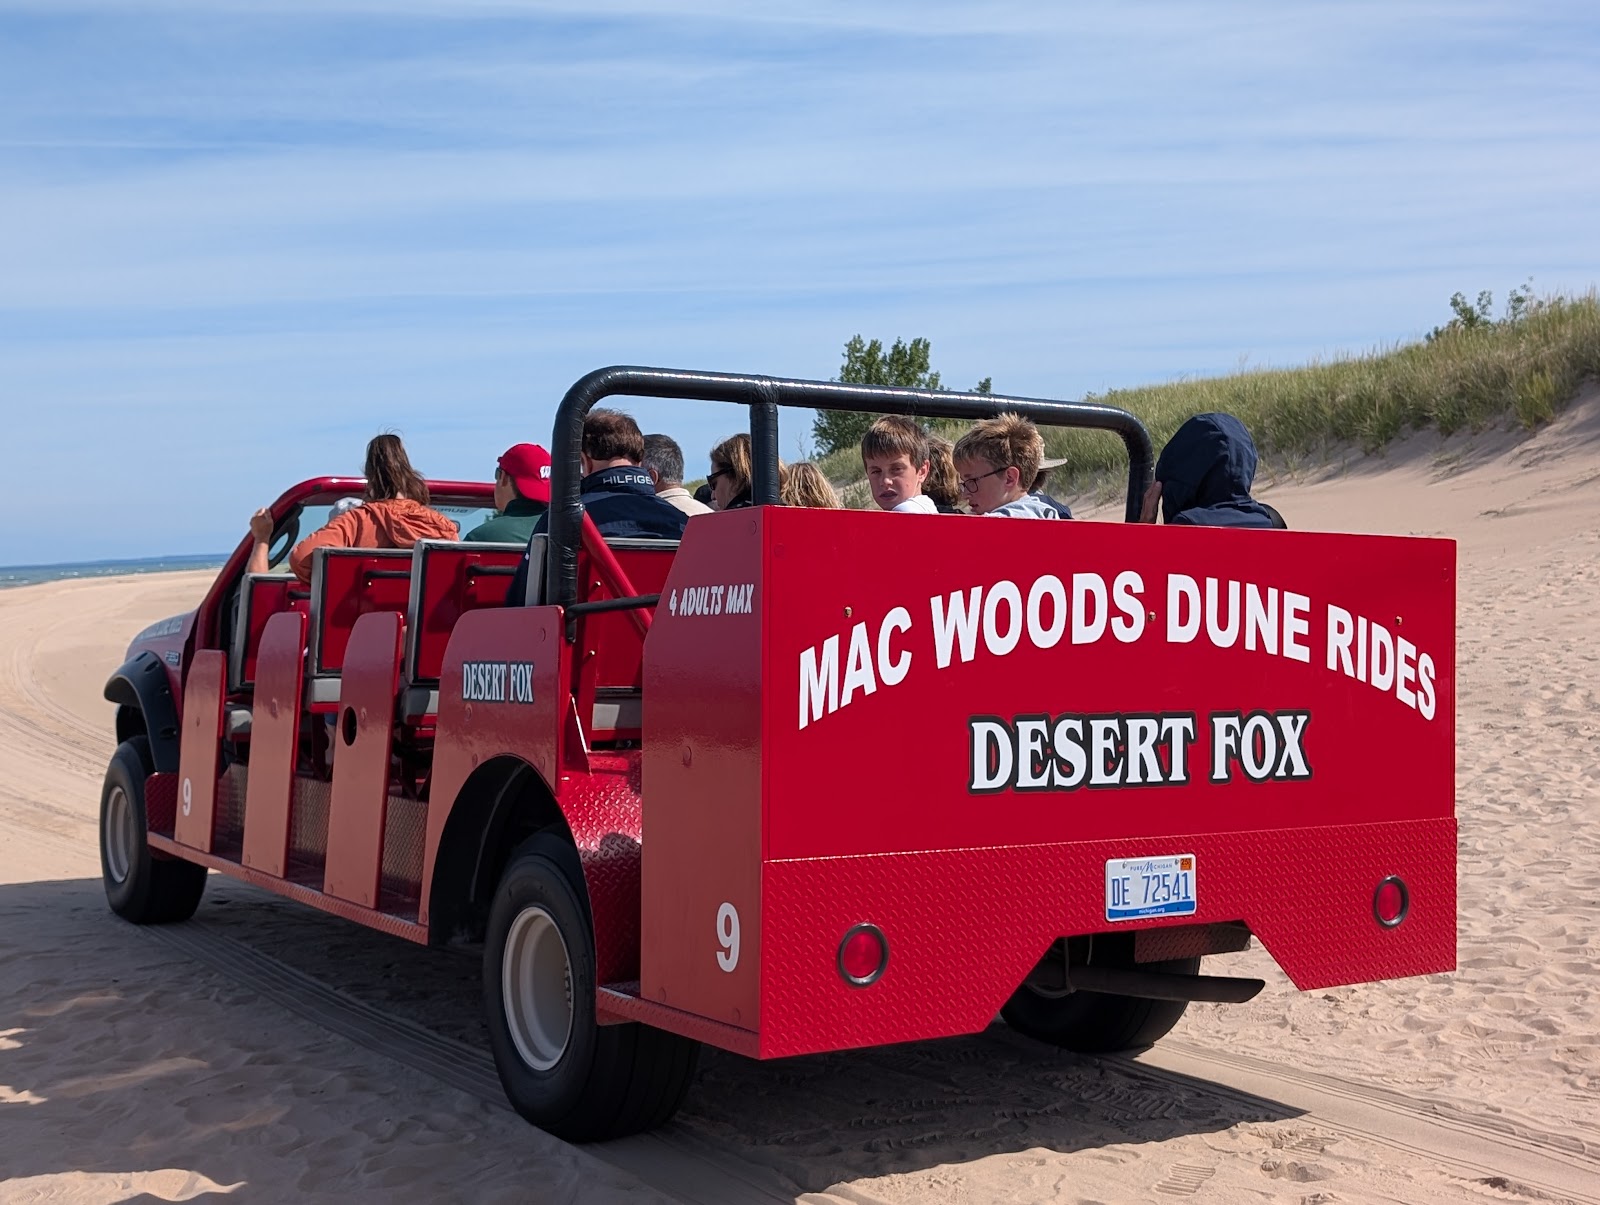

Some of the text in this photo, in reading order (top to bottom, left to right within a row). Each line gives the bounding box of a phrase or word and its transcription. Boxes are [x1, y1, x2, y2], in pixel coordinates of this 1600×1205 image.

[602, 474, 655, 486] HILFIGE
[669, 583, 755, 617] 4 ADULTS MAX
[798, 570, 1437, 731] MAC WOODS DUNE RIDES
[462, 662, 535, 703] DESERT FOX
[970, 713, 1311, 792] DESERT FOX
[182, 777, 192, 817] 9
[1111, 871, 1191, 907] DE 72541
[1138, 906, 1166, 915] michigan.org
[715, 902, 741, 972] 9
